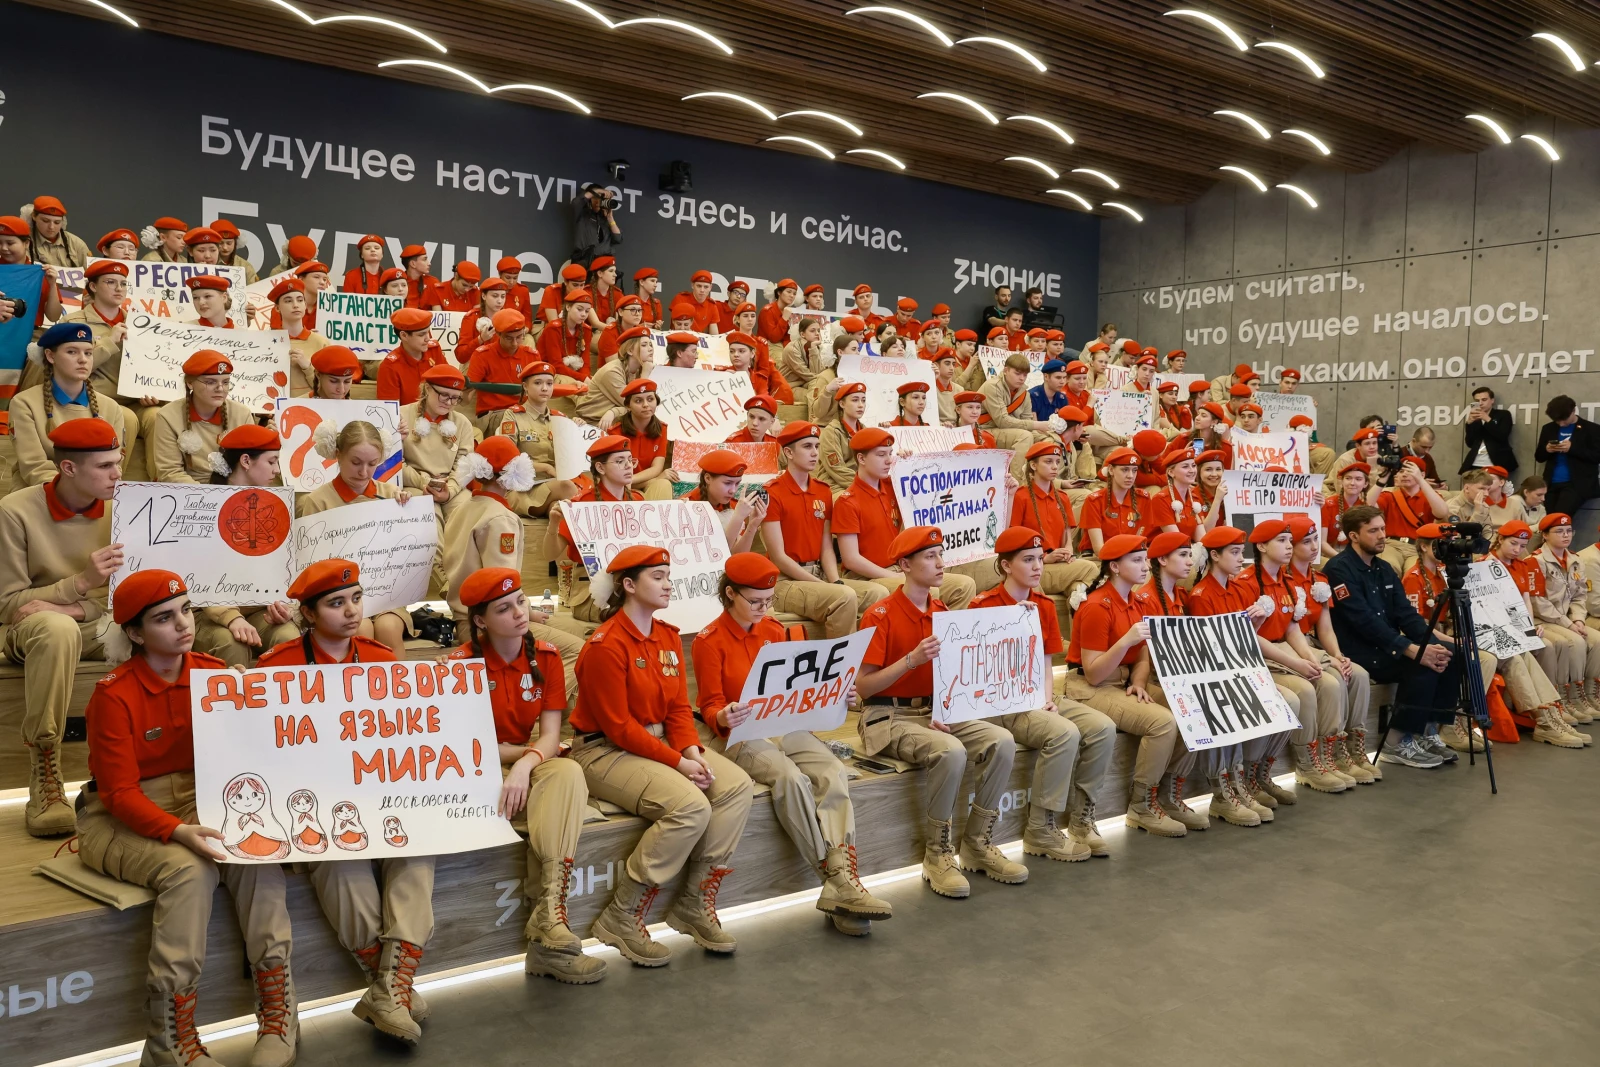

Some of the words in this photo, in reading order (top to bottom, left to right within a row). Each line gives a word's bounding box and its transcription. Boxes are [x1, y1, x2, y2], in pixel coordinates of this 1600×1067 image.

[201, 114, 416, 183] Будущее
[436, 158, 643, 212] наступет
[658, 193, 757, 229] здесь
[770, 210, 787, 235] и
[801, 214, 909, 253] сейчас.
[1143, 284, 1234, 314] «Будем
[1245, 270, 1365, 301] считать,
[133, 315, 260, 349] Оренбургская
[325, 320, 399, 345] ОБЛАСТЬ
[1185, 326, 1228, 346] что
[1238, 311, 1359, 348] будущее
[1374, 301, 1549, 335] началось.
[134, 373, 177, 390] МИССИЯ
[1299, 359, 1389, 383] каким
[1403, 354, 1467, 379] оно
[1482, 347, 1595, 384] будет
[659, 376, 747, 416] ТАТАРСТАН
[678, 392, 745, 438] АЛГА!
[1397, 402, 1539, 427] завиит
[1237, 440, 1287, 466] МОСКВА
[1236, 489, 1251, 506] НЕ
[1255, 491, 1276, 506] ПРО
[1279, 486, 1315, 508] ВОЙНУ!
[1242, 473, 1268, 488] НАШ
[1271, 474, 1311, 489] ВОПРОС
[128, 494, 179, 547] 12
[183, 494, 219, 510] Главное
[913, 486, 997, 527] ПРОПАГАНДА?
[569, 502, 714, 543] КИРОВСКАЯ
[604, 536, 724, 566] ОСТЬ
[201, 669, 326, 713] ДЕТИ
[342, 662, 485, 703] ГОВОРЯТ
[757, 640, 849, 696] ГДЕ
[1192, 672, 1272, 737] КРАЙ
[274, 714, 318, 749] НА
[340, 705, 441, 742] ЯЗЫКЕ
[352, 738, 483, 785] МИРА!
[446, 804, 497, 819] ОБЛАСТЬ
